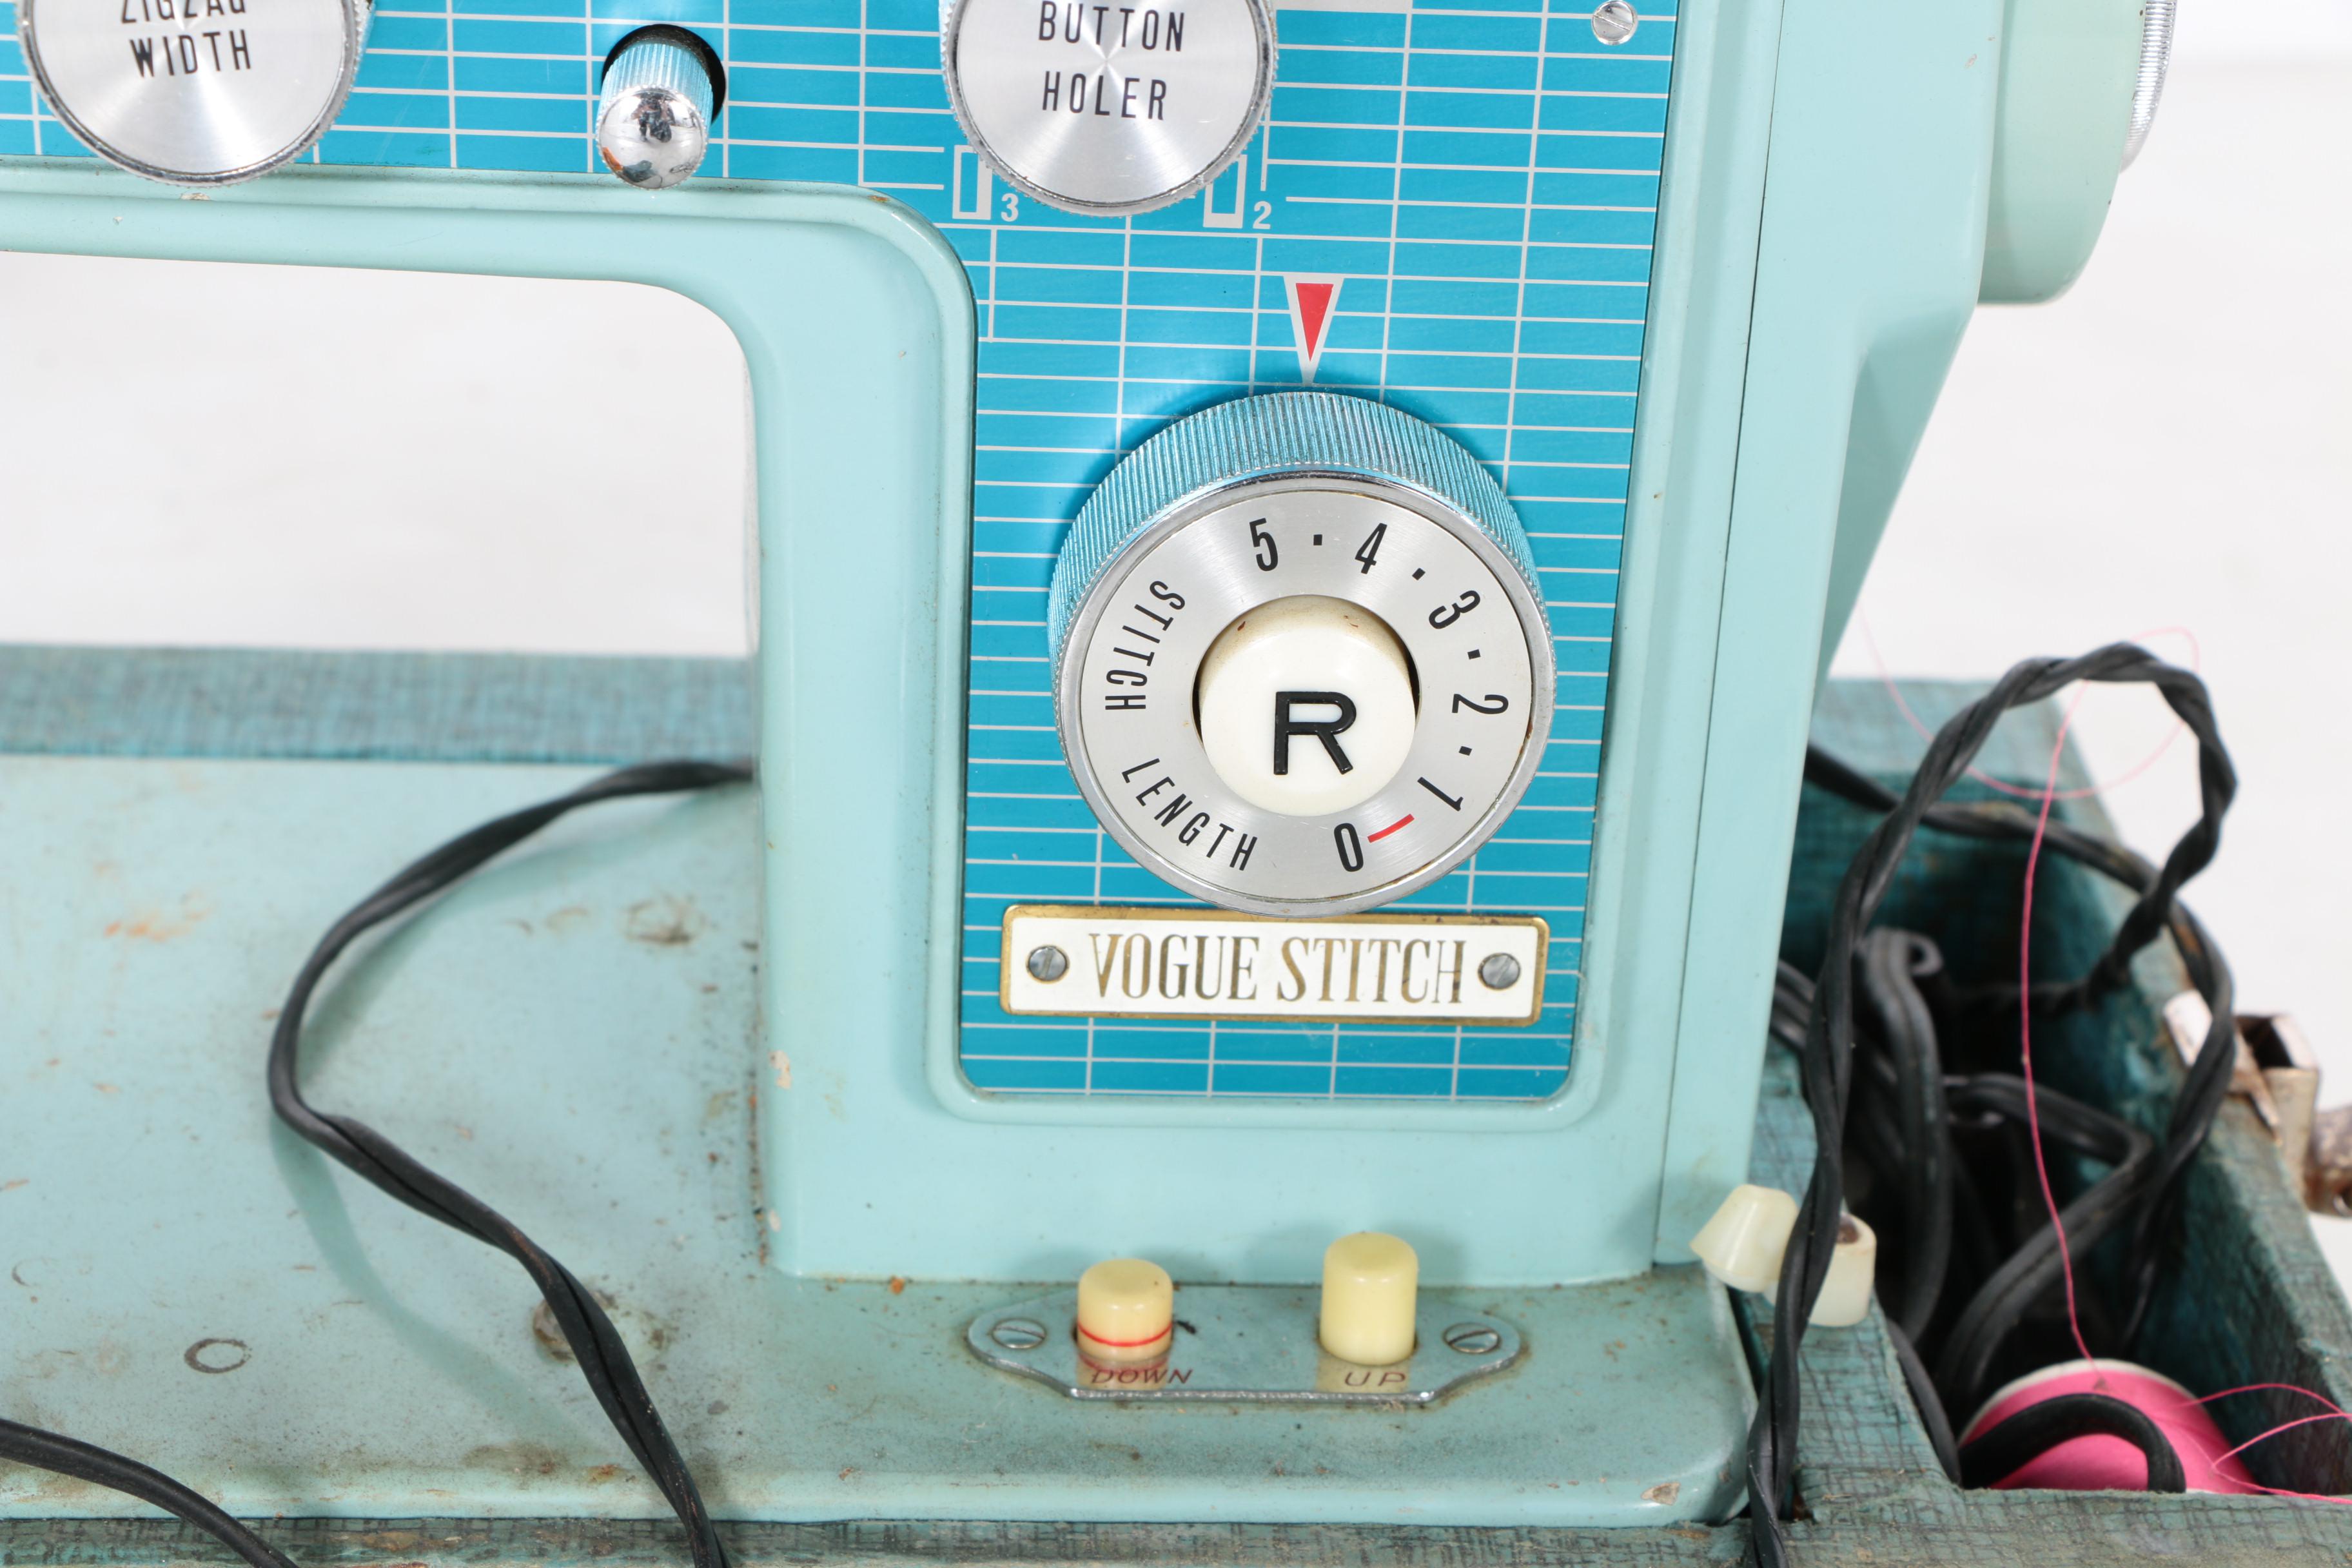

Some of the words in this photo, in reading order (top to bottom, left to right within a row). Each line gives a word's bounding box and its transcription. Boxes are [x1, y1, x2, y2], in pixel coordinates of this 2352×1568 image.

[1038, 1, 1184, 52] BUTTON
[130, 29, 251, 77] WIDTH
[1042, 71, 1167, 121] HOLER
[1001, 193, 1019, 222] 3
[1253, 201, 1271, 230] 2
[1249, 518, 1279, 572] 5
[1355, 523, 1387, 574] 4
[1428, 590, 1481, 629] 3
[1104, 580, 1186, 710] STITCH
[1452, 694, 1509, 714] 2
[1273, 691, 1357, 776] R
[1121, 758, 1258, 872] LENGTH
[1417, 776, 1464, 812] 1
[1333, 822, 1364, 872] 0
[1088, 932, 1260, 1001] VOGUE
[1277, 937, 1467, 1004] STITCH
[1091, 1367, 1193, 1384] DOWN
[1345, 1371, 1406, 1387] UP
